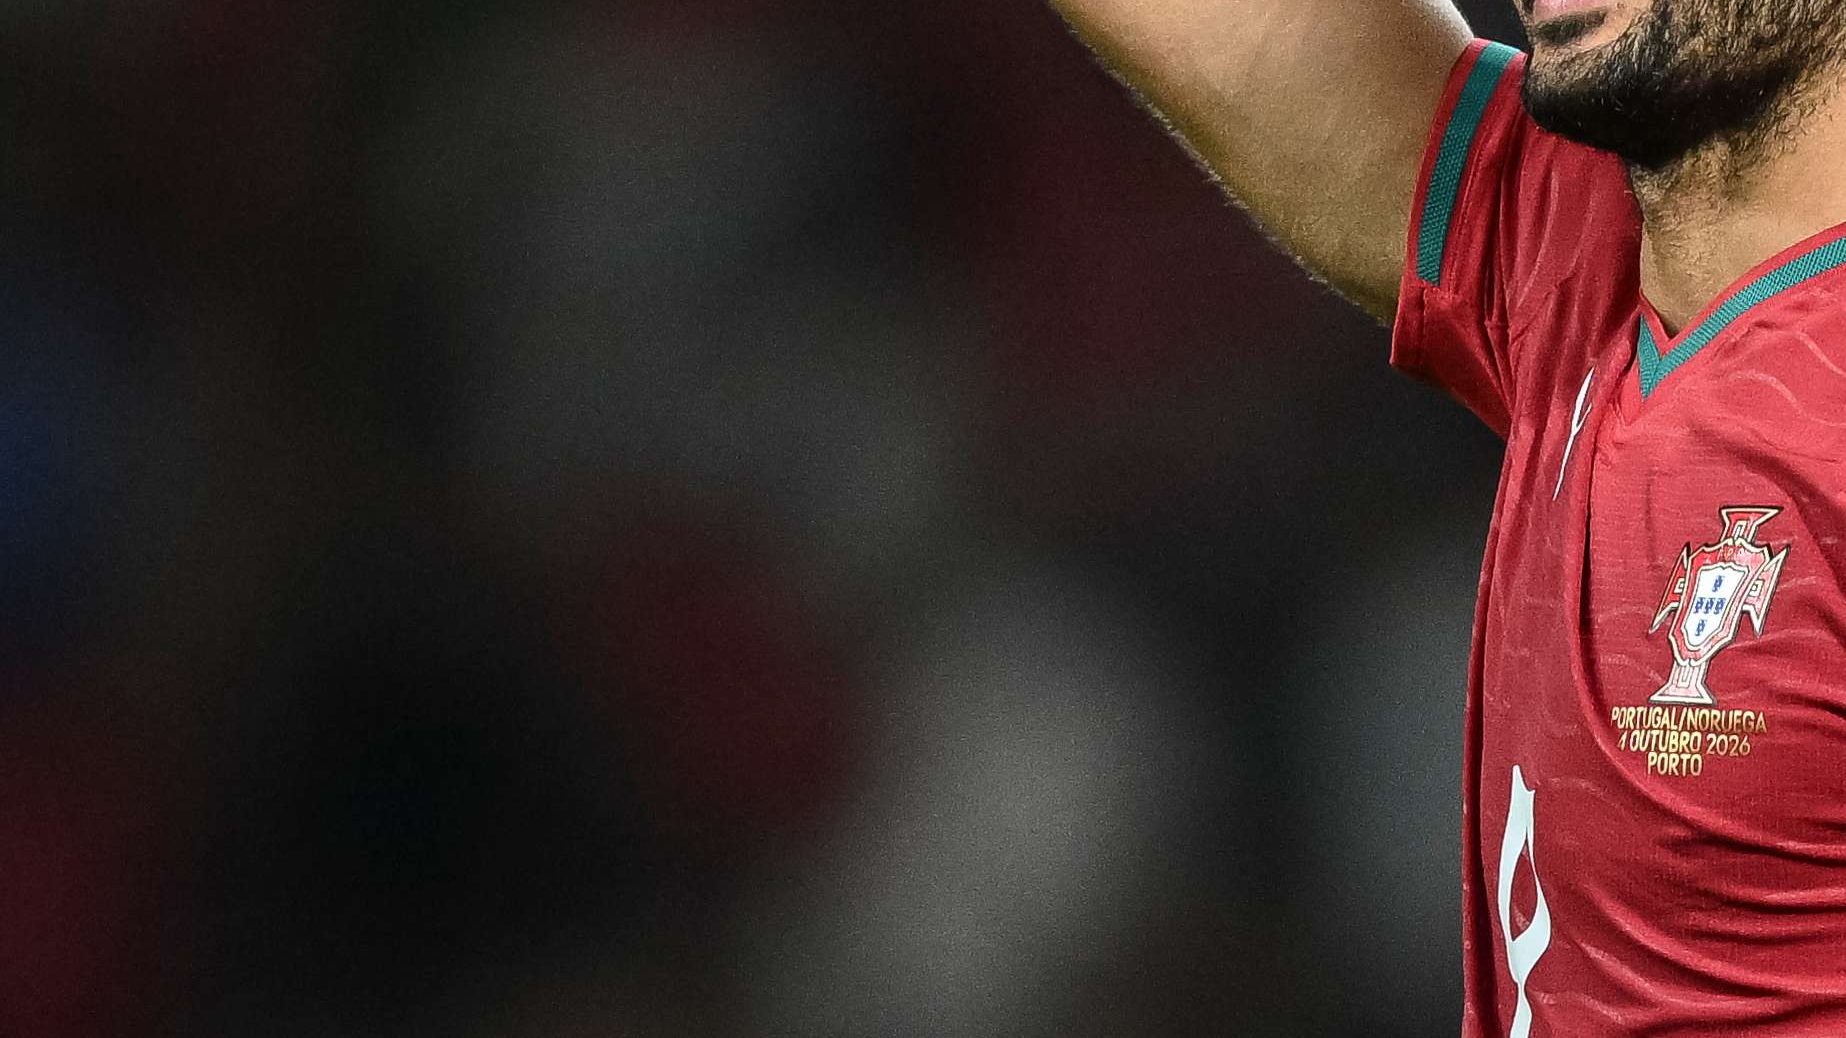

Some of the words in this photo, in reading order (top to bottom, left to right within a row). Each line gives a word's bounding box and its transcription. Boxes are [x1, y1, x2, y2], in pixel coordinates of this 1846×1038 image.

[1611, 706, 1767, 733] PORTUGAL/NORUEGA
[1629, 729, 1702, 753] OUTUBRO
[1706, 733, 1751, 757] 2026
[1647, 751, 1703, 777] PORTO
[1497, 764, 1552, 1038] 9
